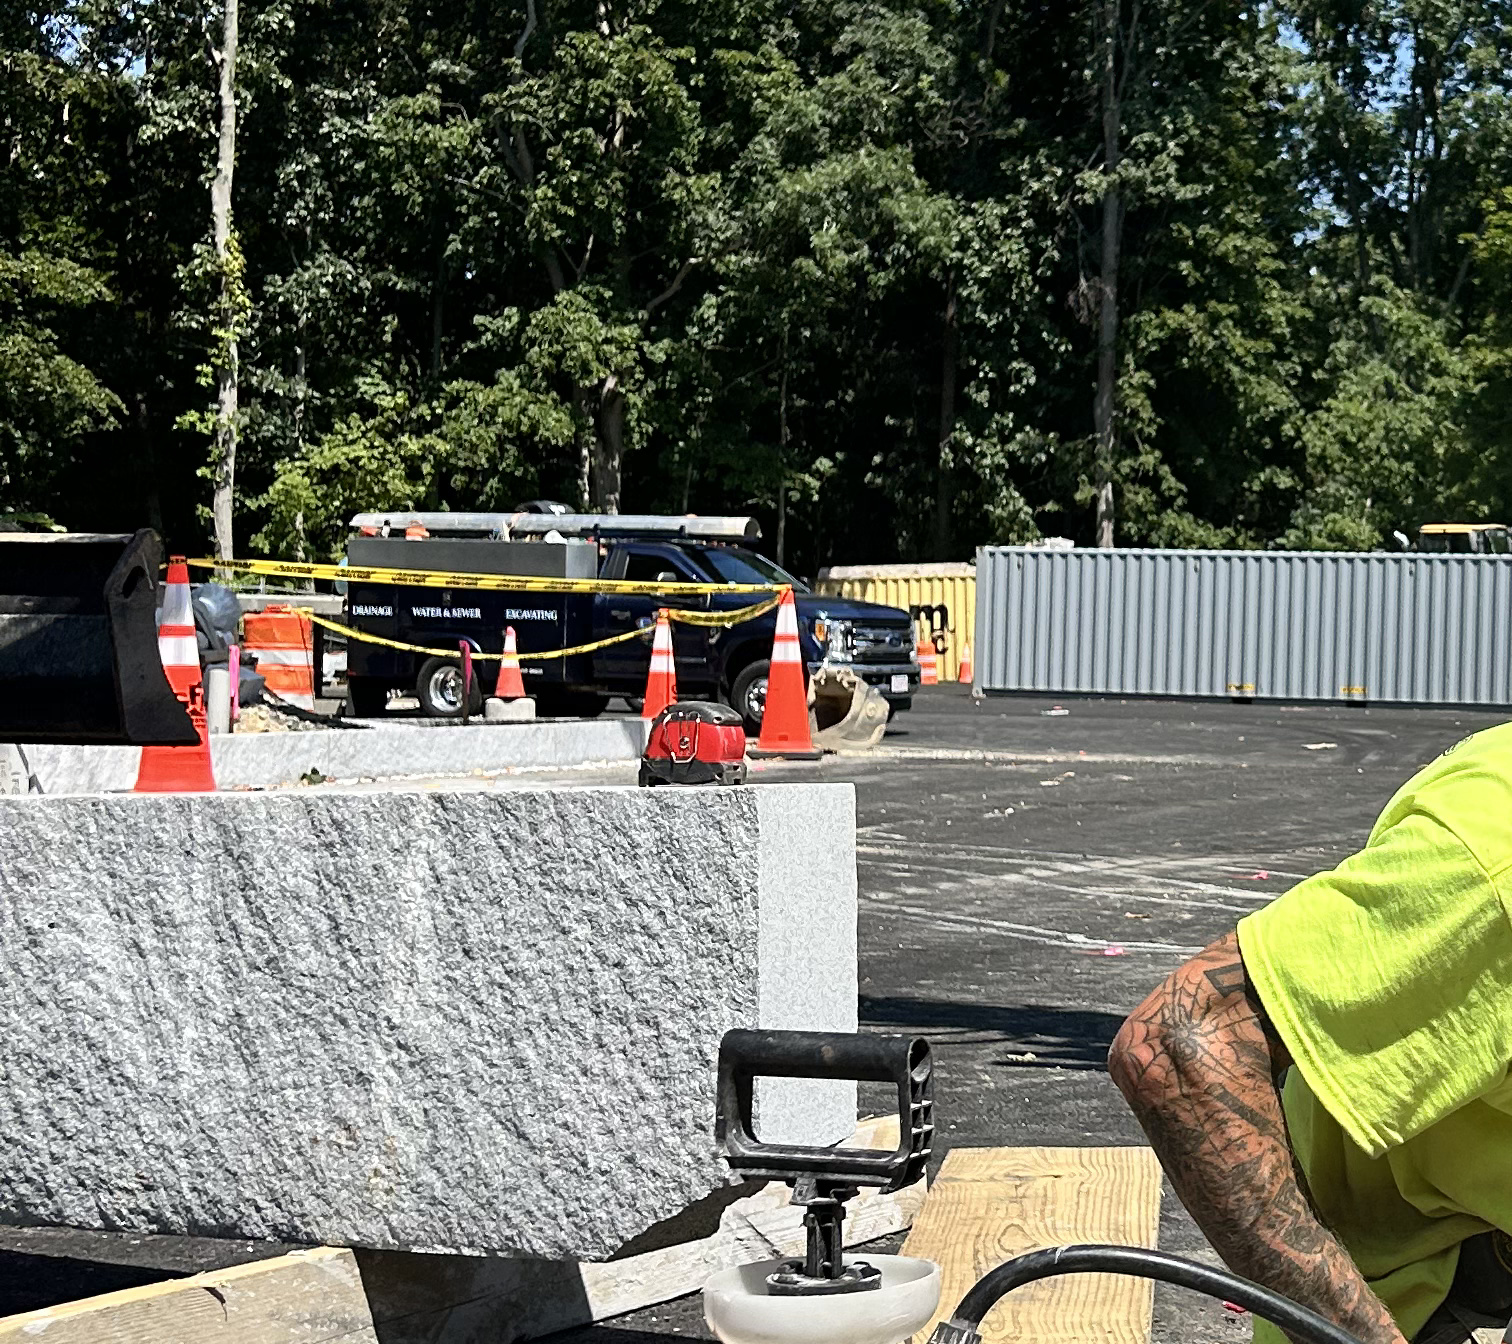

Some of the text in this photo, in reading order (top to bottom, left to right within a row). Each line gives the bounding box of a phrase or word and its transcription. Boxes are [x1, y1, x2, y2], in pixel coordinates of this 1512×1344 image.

[352, 605, 393, 617] DRAINAGE
[412, 606, 442, 618] WATER
[452, 608, 482, 619] SEWER
[505, 608, 558, 621] EXCAVATING
